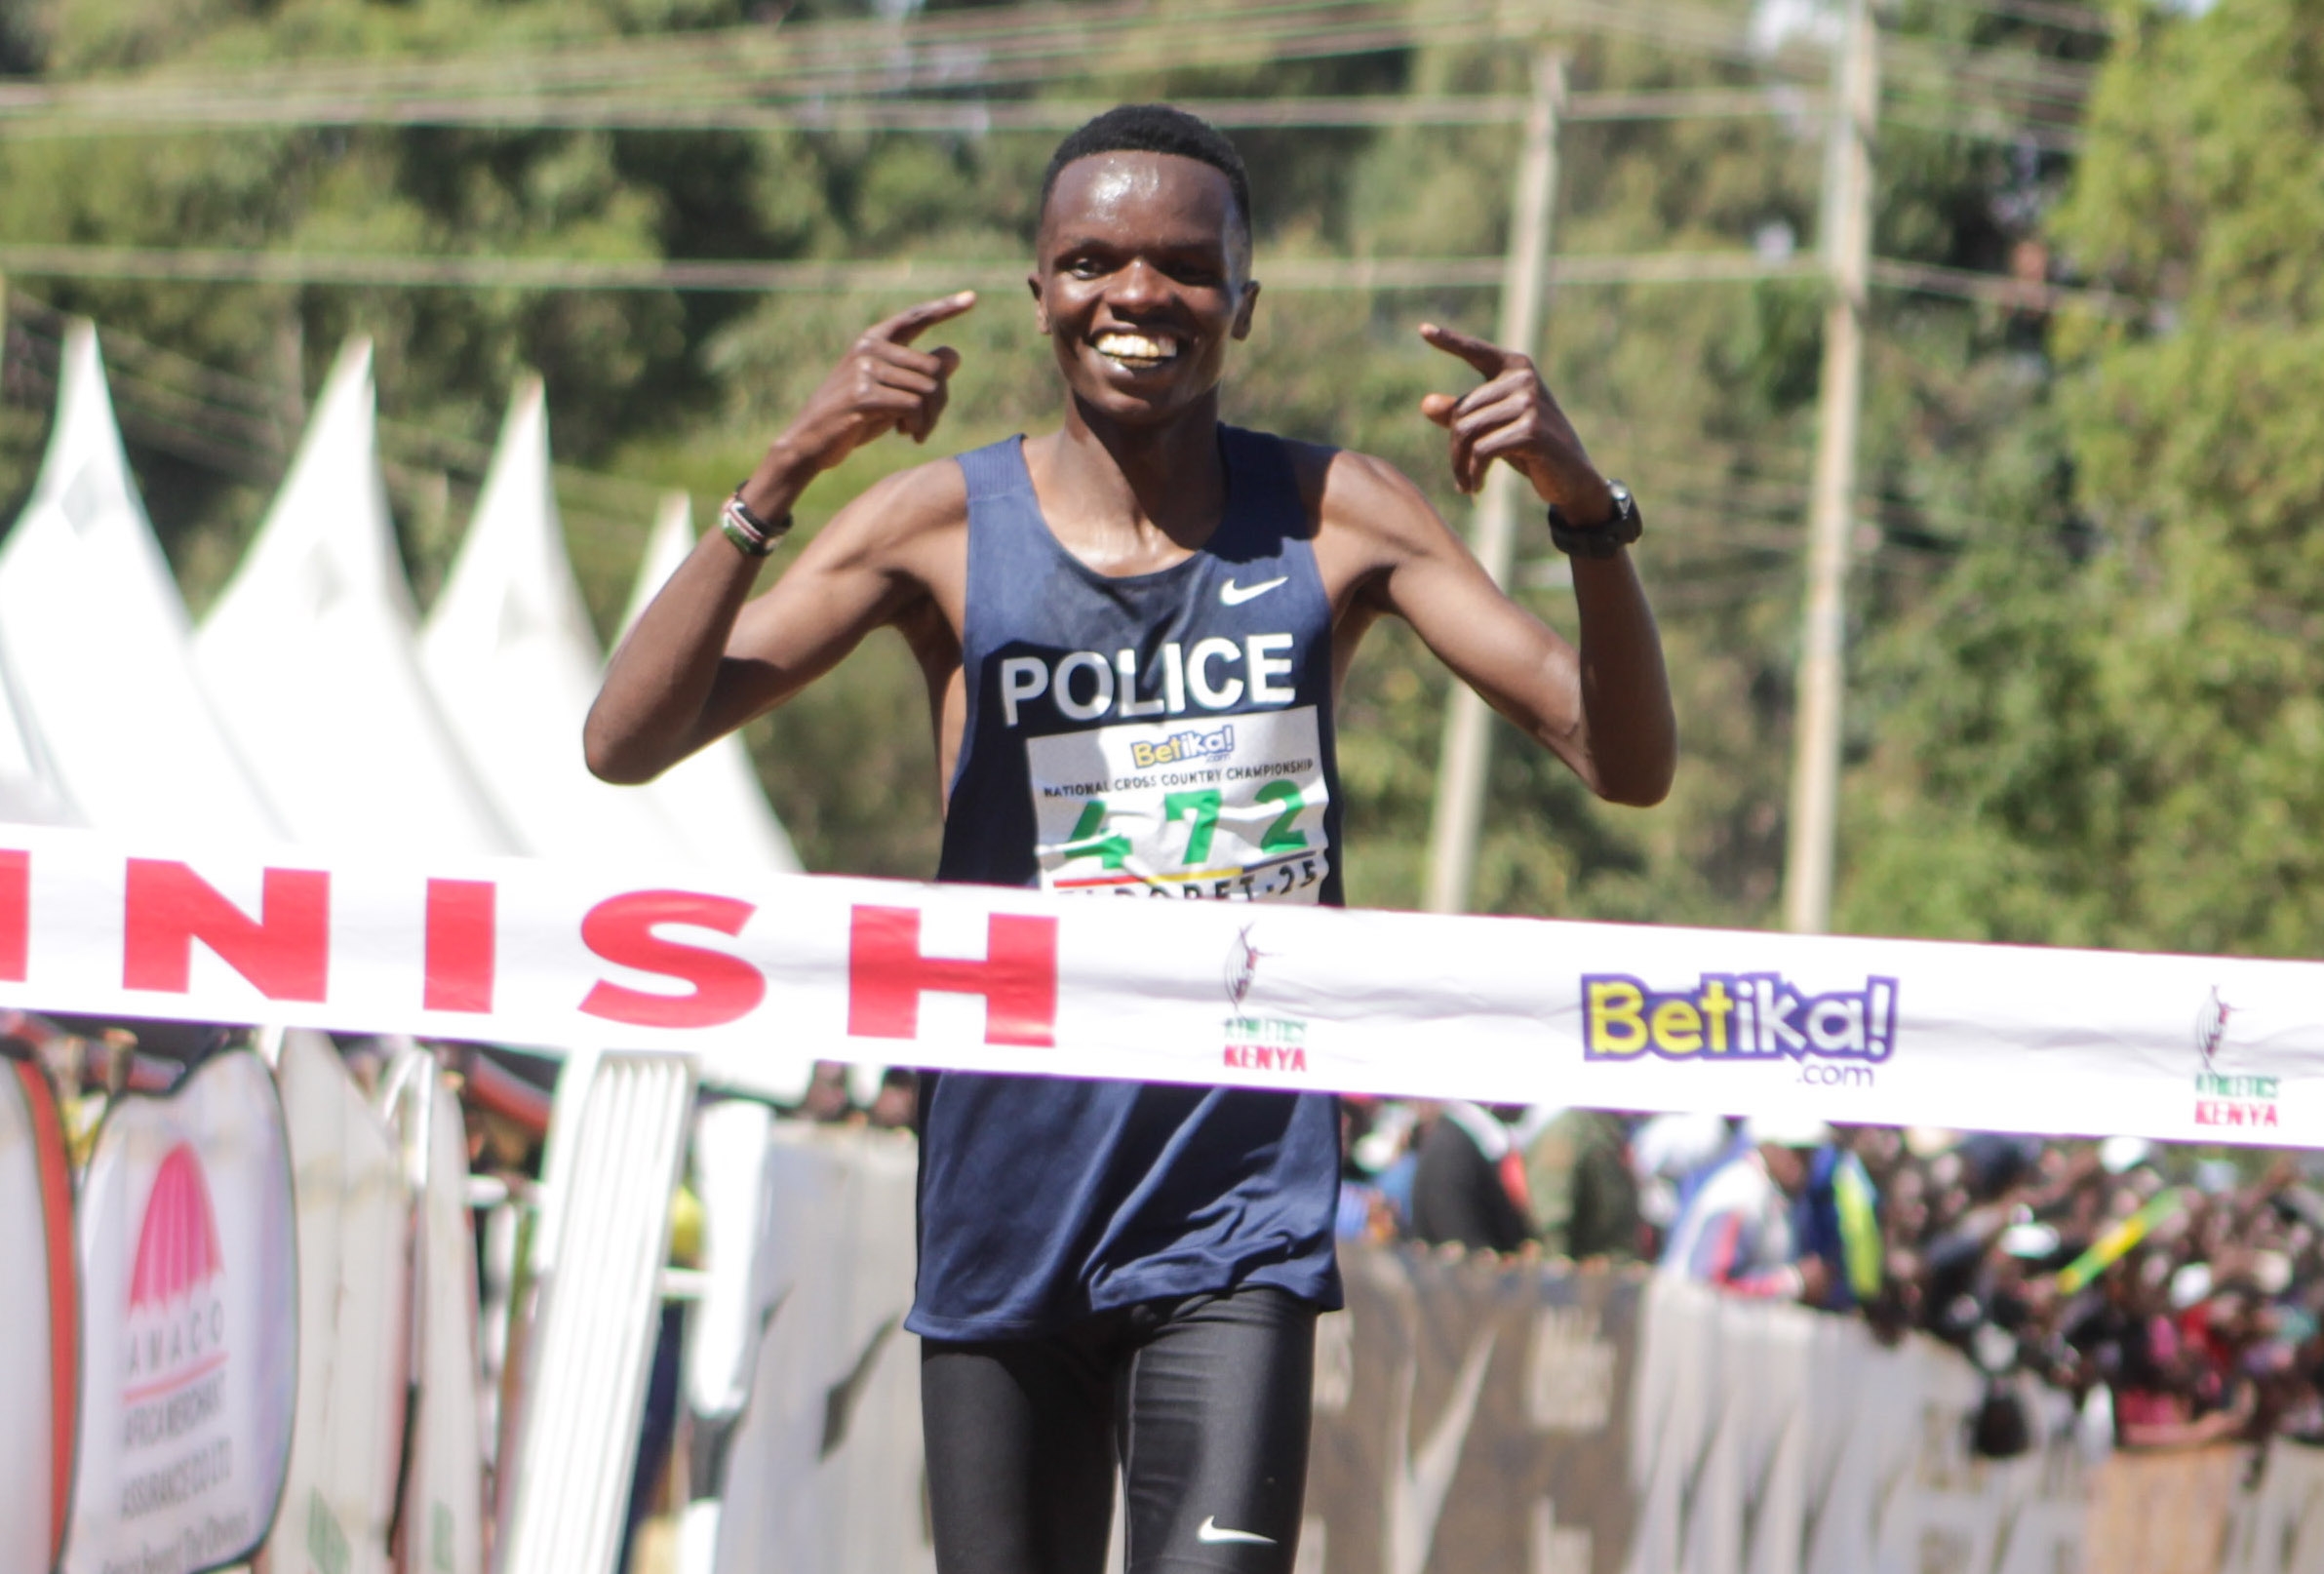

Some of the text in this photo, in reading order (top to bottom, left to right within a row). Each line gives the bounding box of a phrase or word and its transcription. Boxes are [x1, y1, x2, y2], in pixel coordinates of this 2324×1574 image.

[1001, 632, 1296, 728] POLICE
[1131, 726, 1236, 769] Betika!
[1044, 758, 1315, 798] NATIONAL CROSS COUNTRY CHAMPIONSHIP
[1582, 972, 1899, 1063] Betika!
[1224, 1044, 1307, 1072] KENYA
[1795, 1063, 1875, 1088] .com
[2195, 1100, 2278, 1127] KENYA
